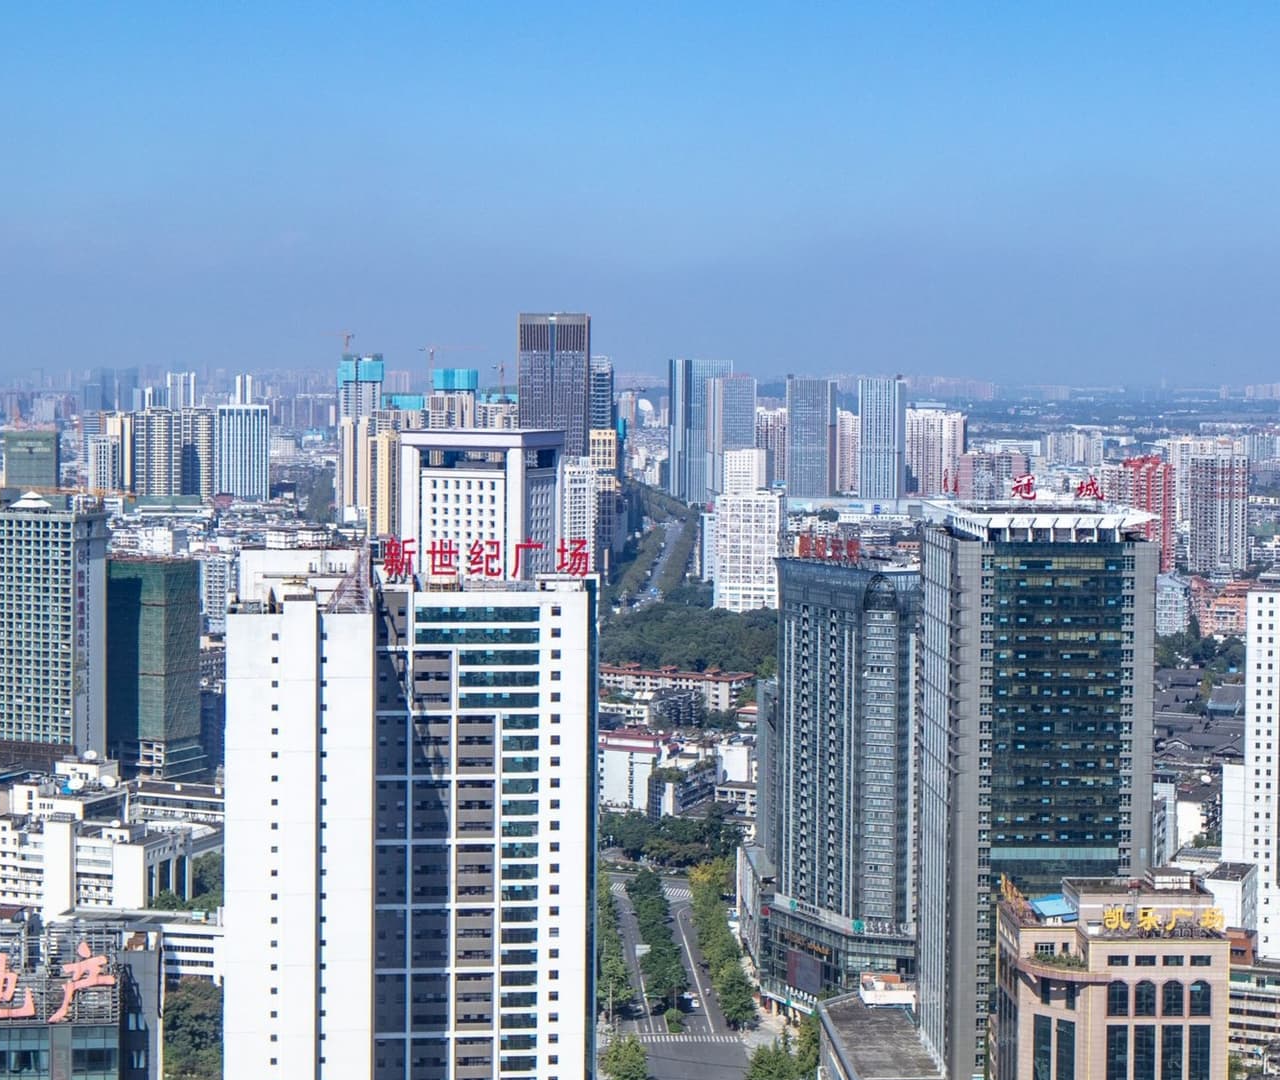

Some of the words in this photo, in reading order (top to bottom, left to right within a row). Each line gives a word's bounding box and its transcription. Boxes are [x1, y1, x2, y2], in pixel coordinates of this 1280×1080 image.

[1012, 473, 1104, 499] 冠城
[383, 537, 589, 577] 新世纪广场
[1103, 906, 1226, 931] 凯乐广场
